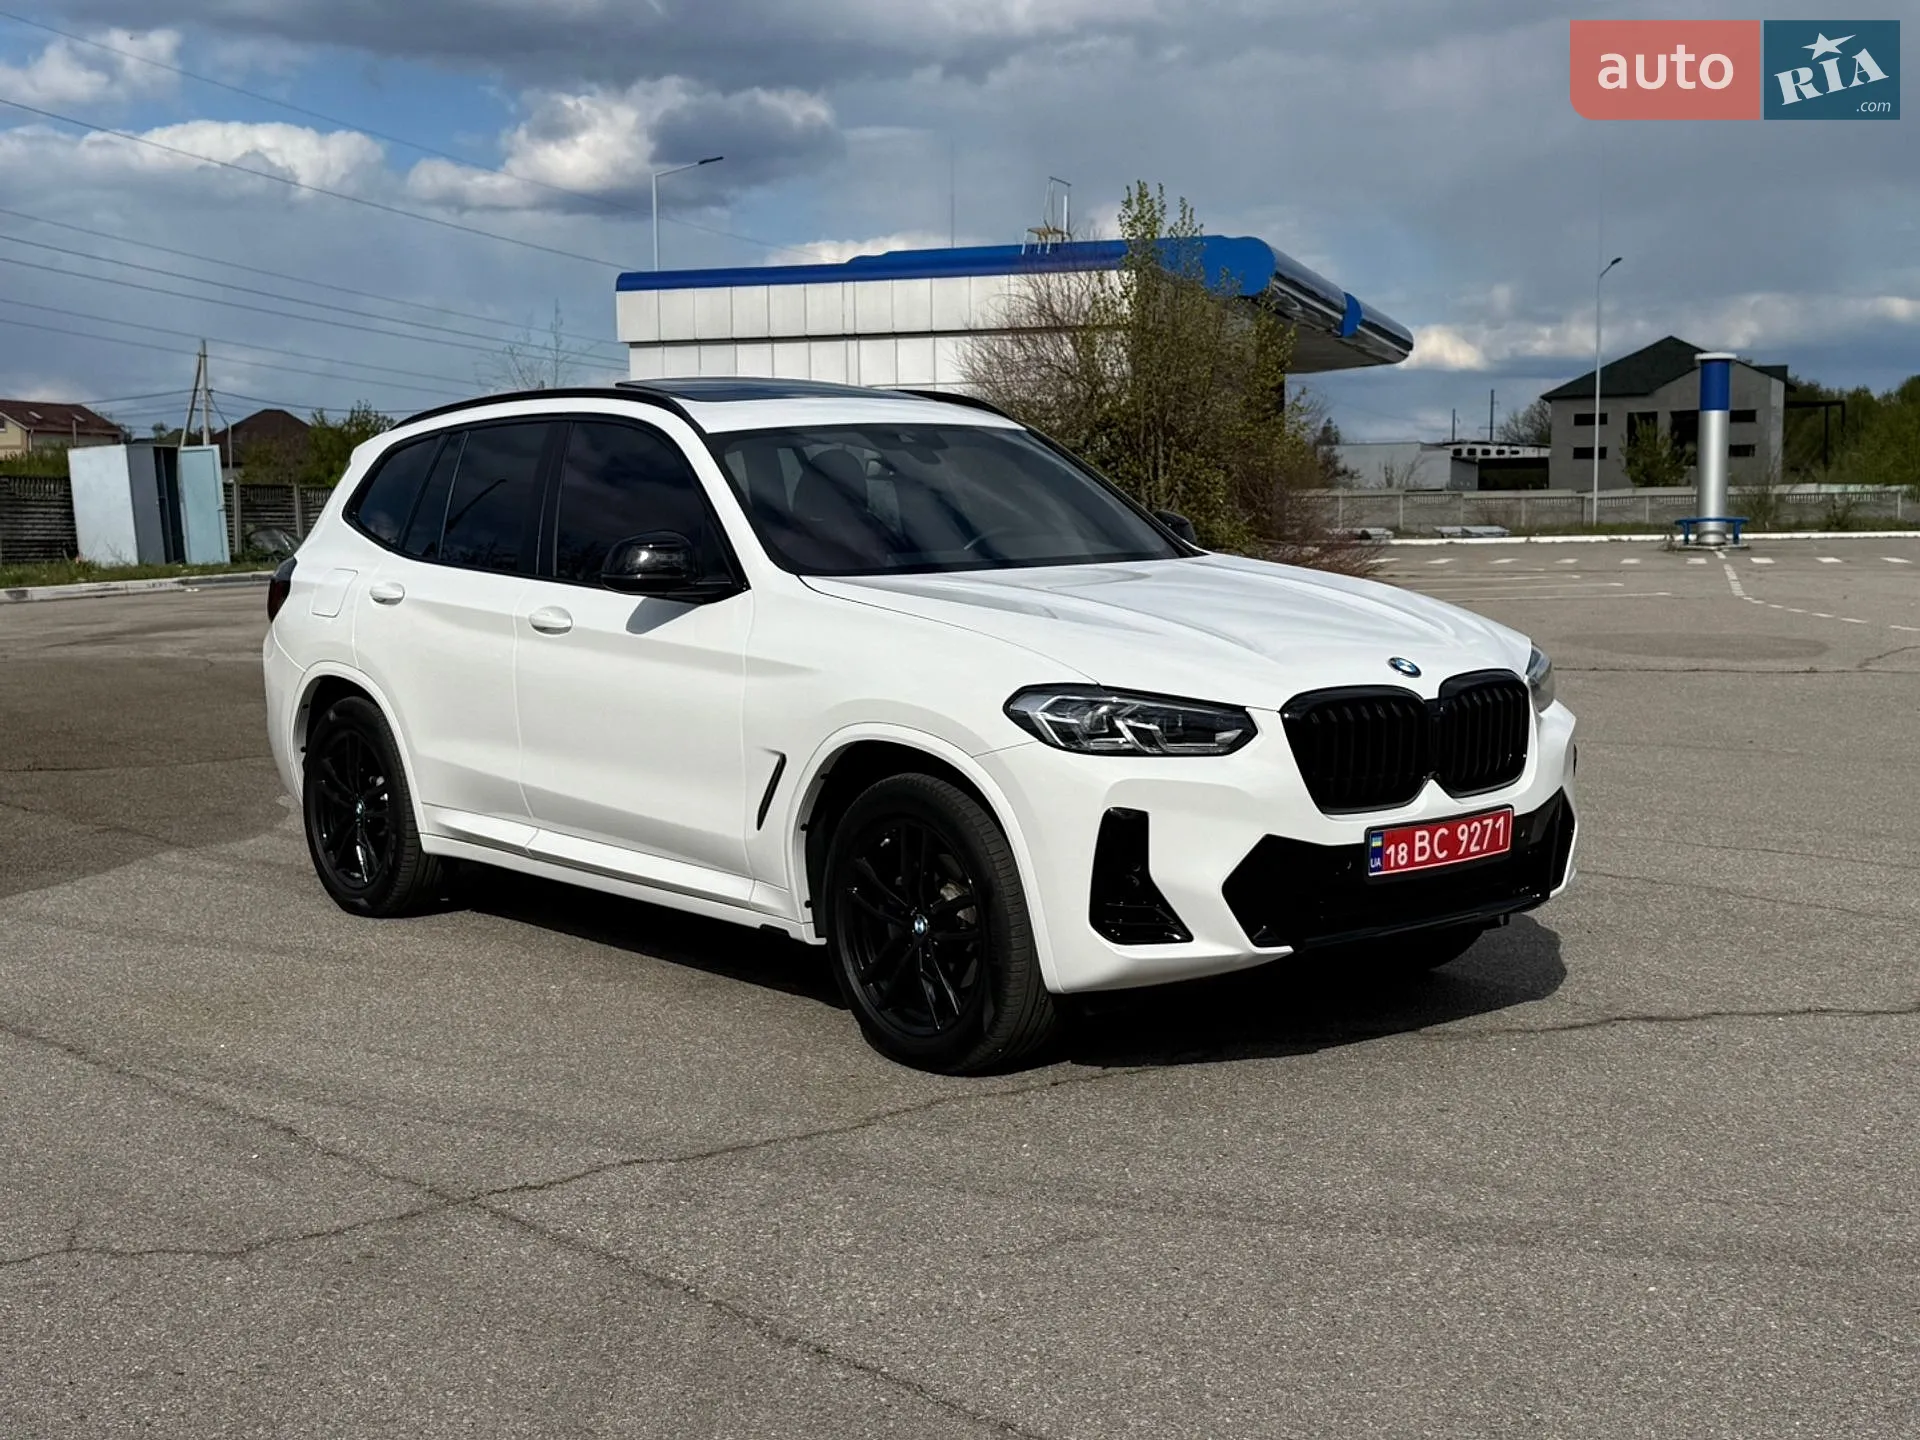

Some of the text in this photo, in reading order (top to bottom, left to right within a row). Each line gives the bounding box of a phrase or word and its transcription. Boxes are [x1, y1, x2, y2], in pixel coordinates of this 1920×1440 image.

[1386, 816, 1505, 867] 18 BC 9271
[1370, 857, 1382, 868] UA
